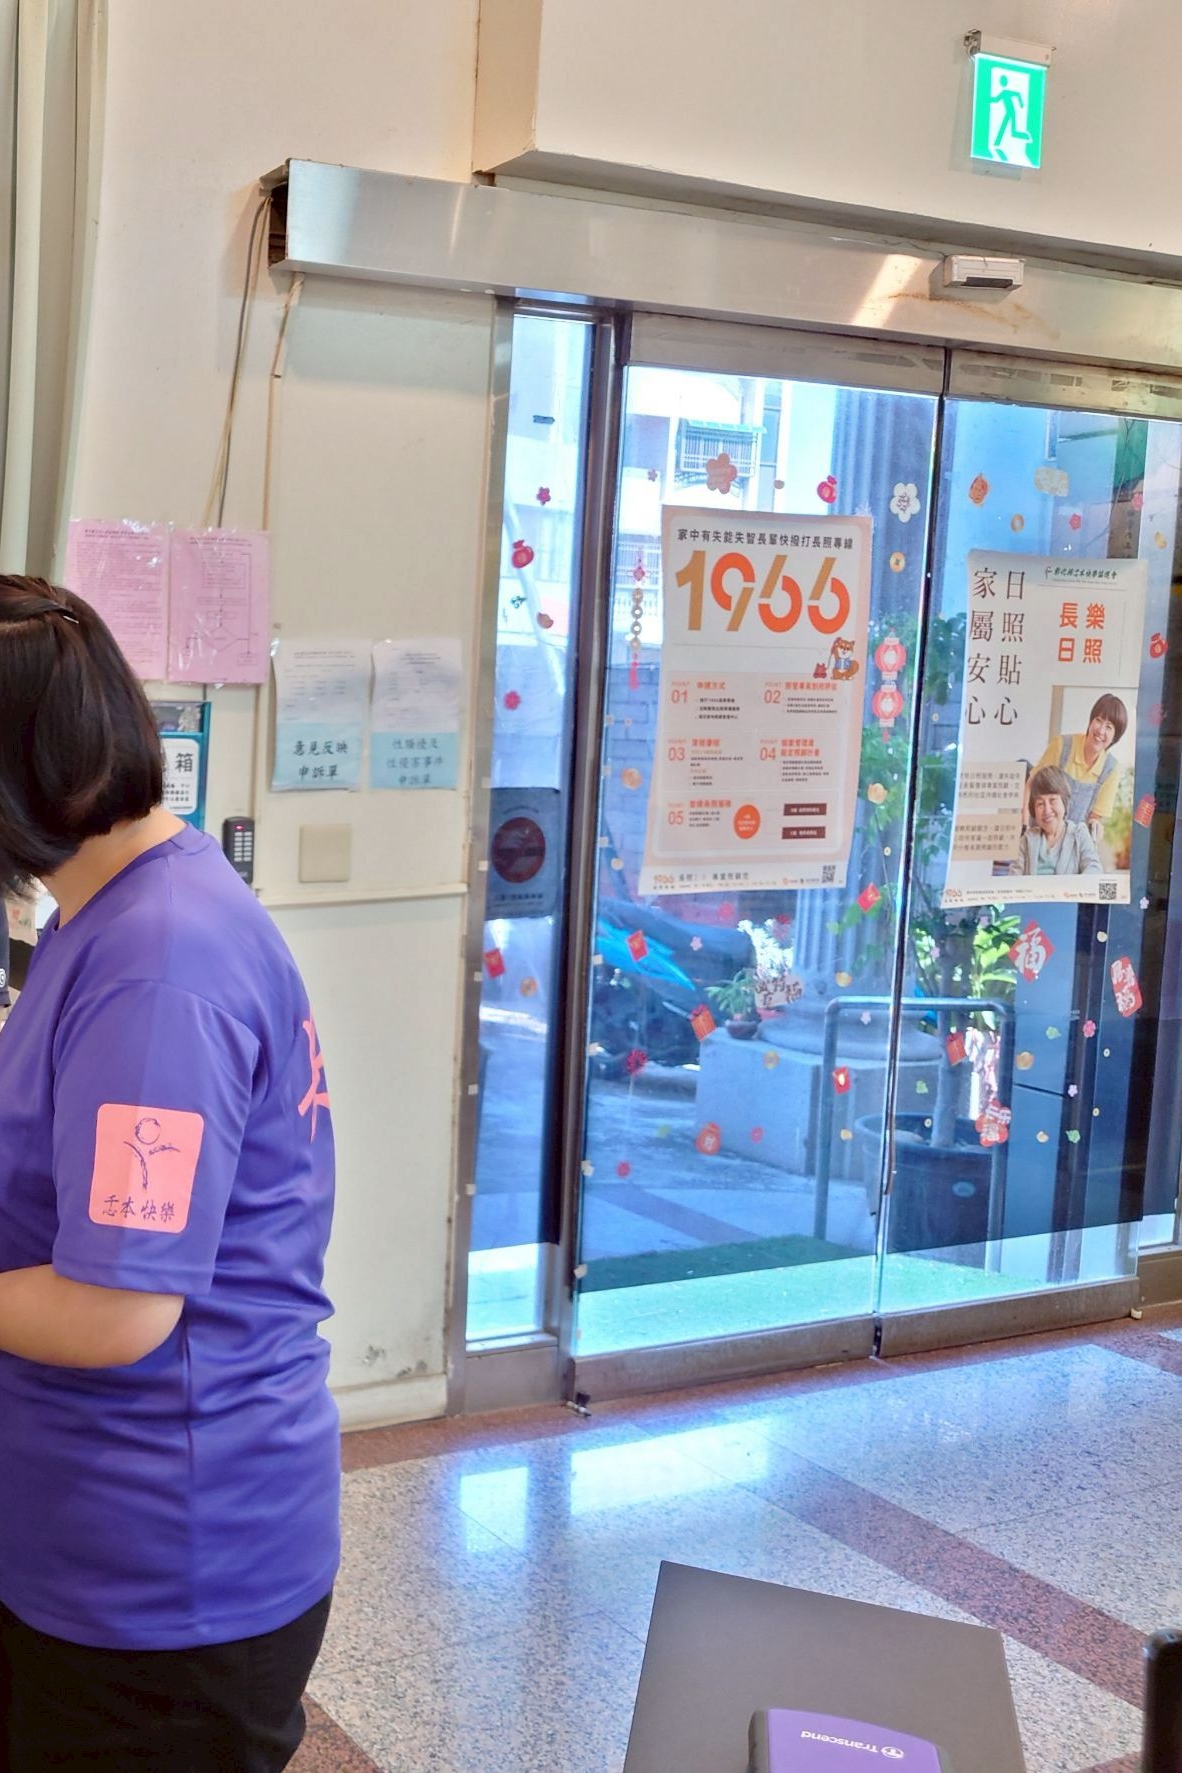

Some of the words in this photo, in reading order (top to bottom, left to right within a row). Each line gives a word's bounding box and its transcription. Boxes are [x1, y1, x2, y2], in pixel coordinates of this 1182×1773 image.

[675, 550, 851, 635] 1966
[1059, 602, 1106, 630] 長樂
[965, 567, 998, 726] 家屬安心
[994, 570, 1026, 726] 日照貼心
[1057, 637, 1103, 664] 日照
[671, 689, 689, 704] 01
[764, 689, 781, 704] 02
[175, 752, 194, 773] 箱
[668, 746, 686, 761] 03
[760, 746, 776, 761] 04
[669, 810, 684, 825] 05
[801, 1730, 879, 1754] Transcend
